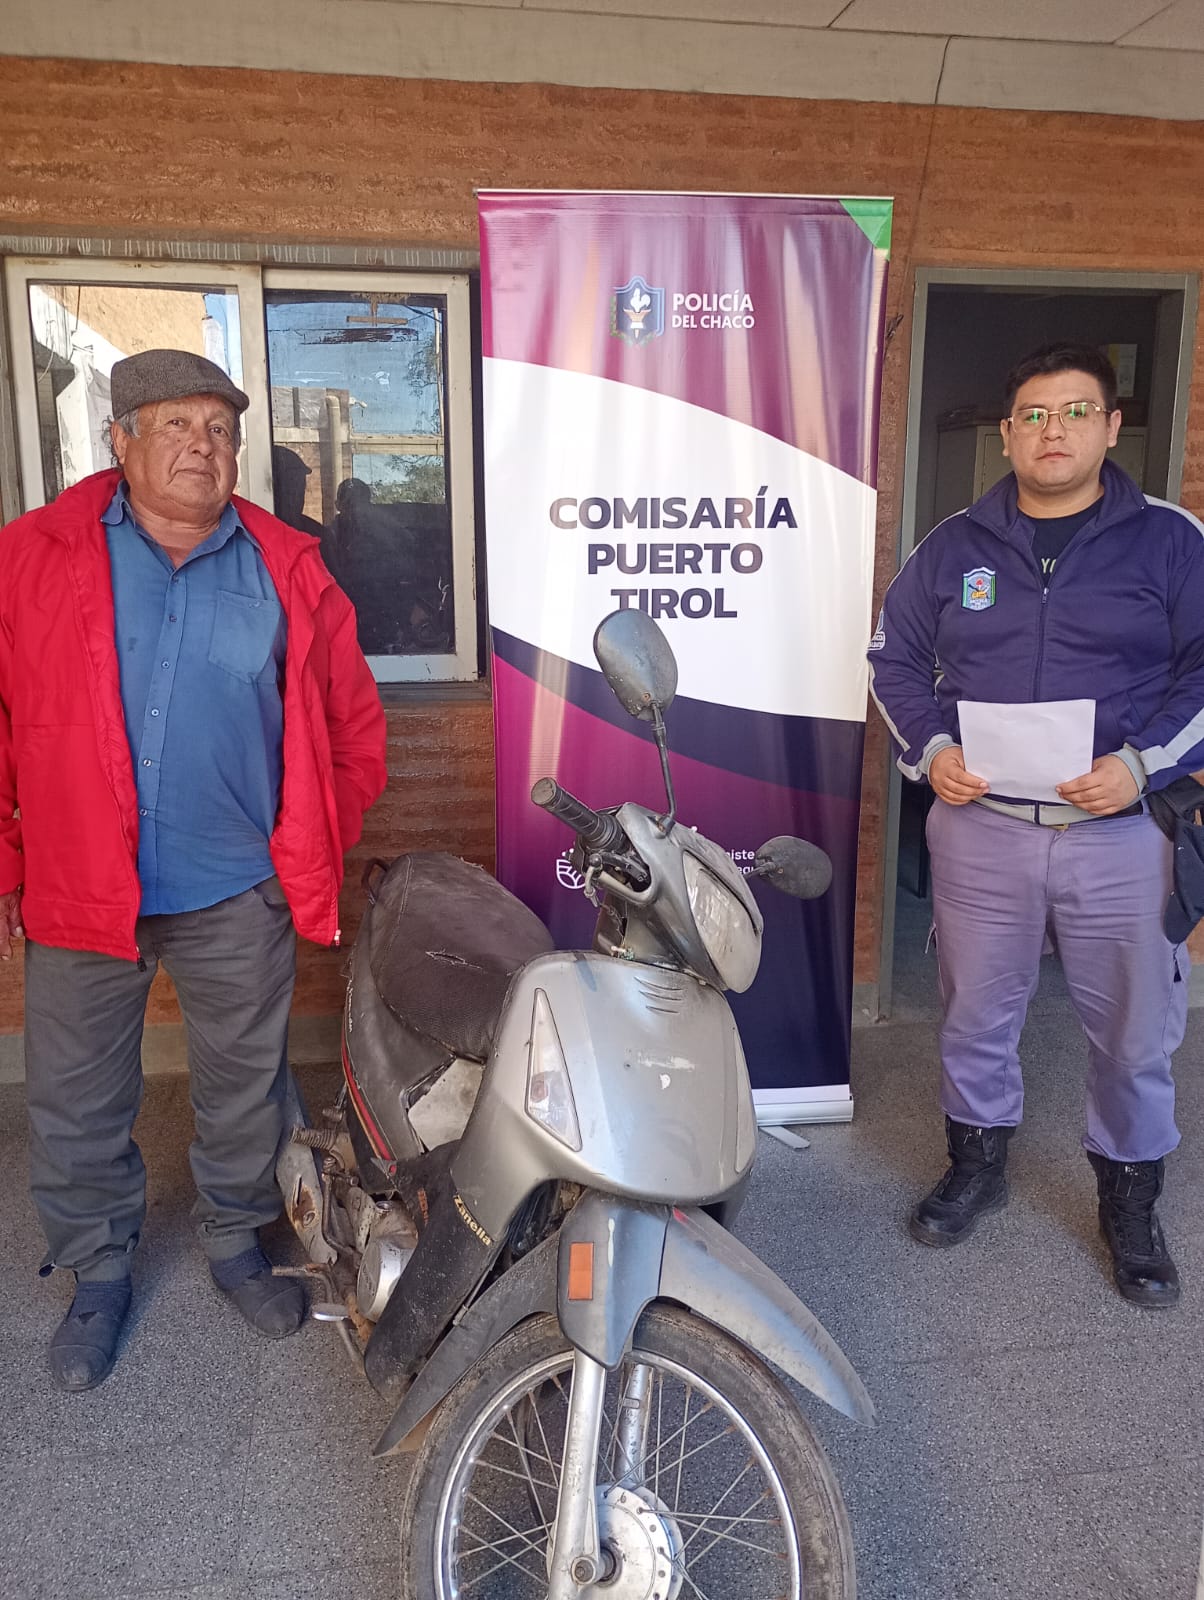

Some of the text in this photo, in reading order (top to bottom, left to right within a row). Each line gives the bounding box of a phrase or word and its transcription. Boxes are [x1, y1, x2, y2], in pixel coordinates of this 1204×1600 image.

[672, 290, 755, 312] POLICÍA
[672, 315, 755, 329] DEL CHACO
[549, 485, 798, 530] COMISARÍA
[587, 542, 763, 575] PUERTO
[610, 587, 738, 619] TIROL
[453, 1194, 492, 1247] Zanella
